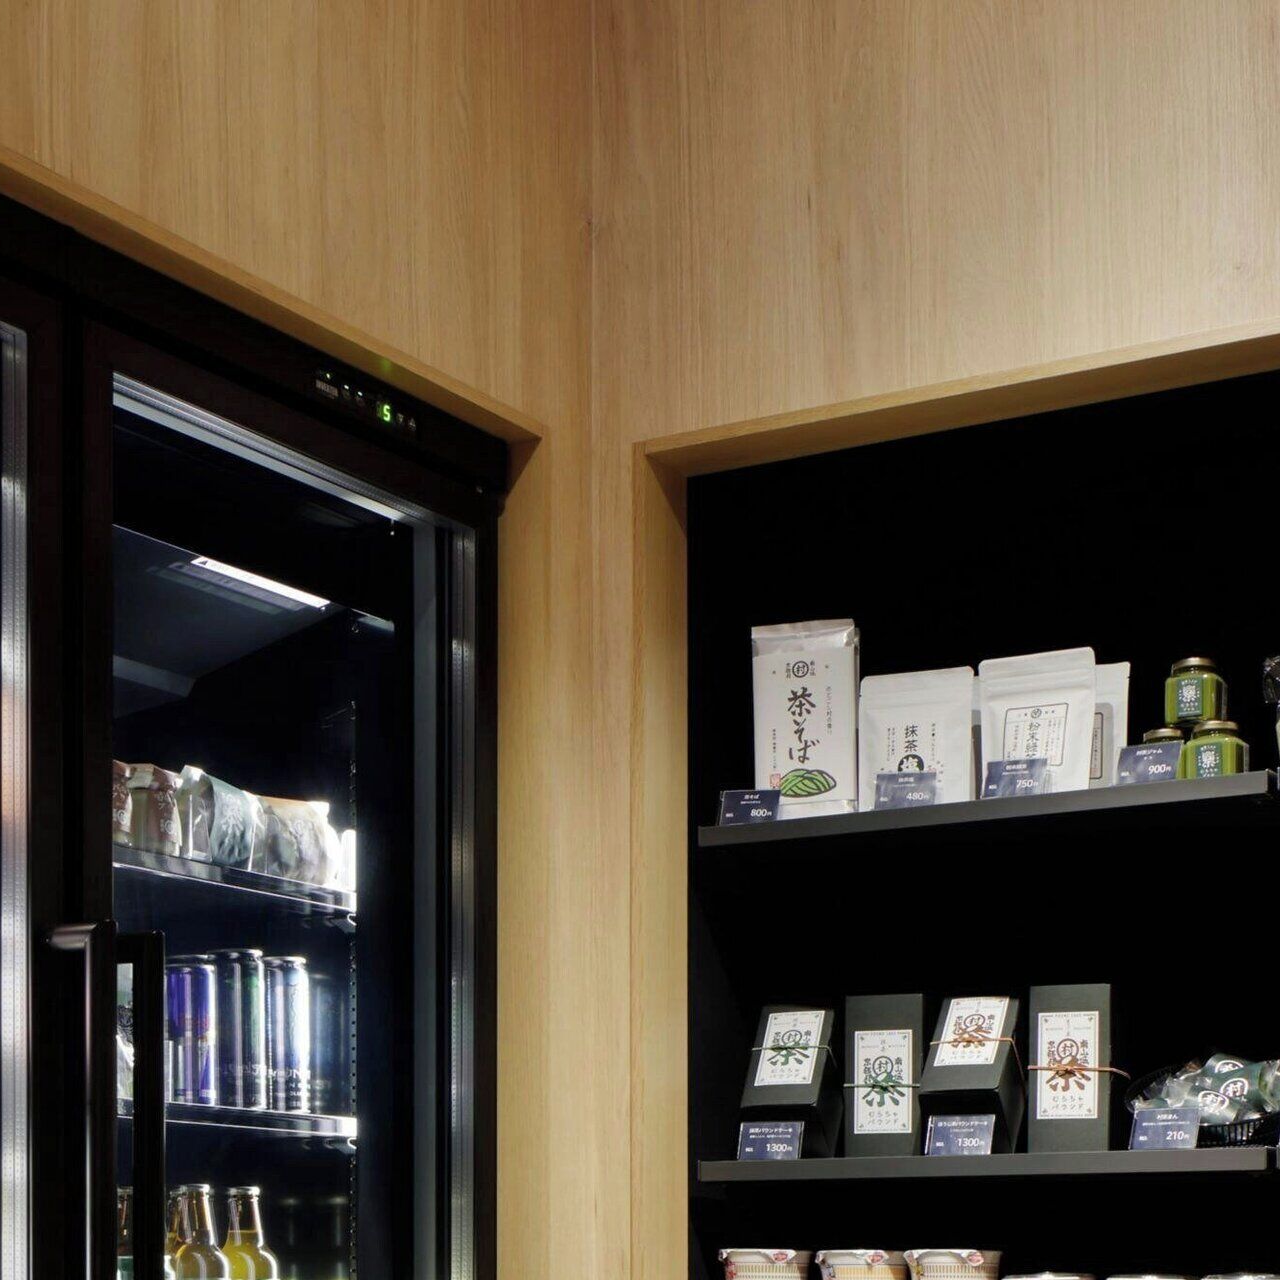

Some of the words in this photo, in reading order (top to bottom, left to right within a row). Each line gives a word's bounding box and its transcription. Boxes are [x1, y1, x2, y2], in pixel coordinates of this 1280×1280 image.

[382, 404, 391, 422] 5
[787, 686, 821, 764] 茶そば
[1166, 1130, 1190, 1141] 210円
